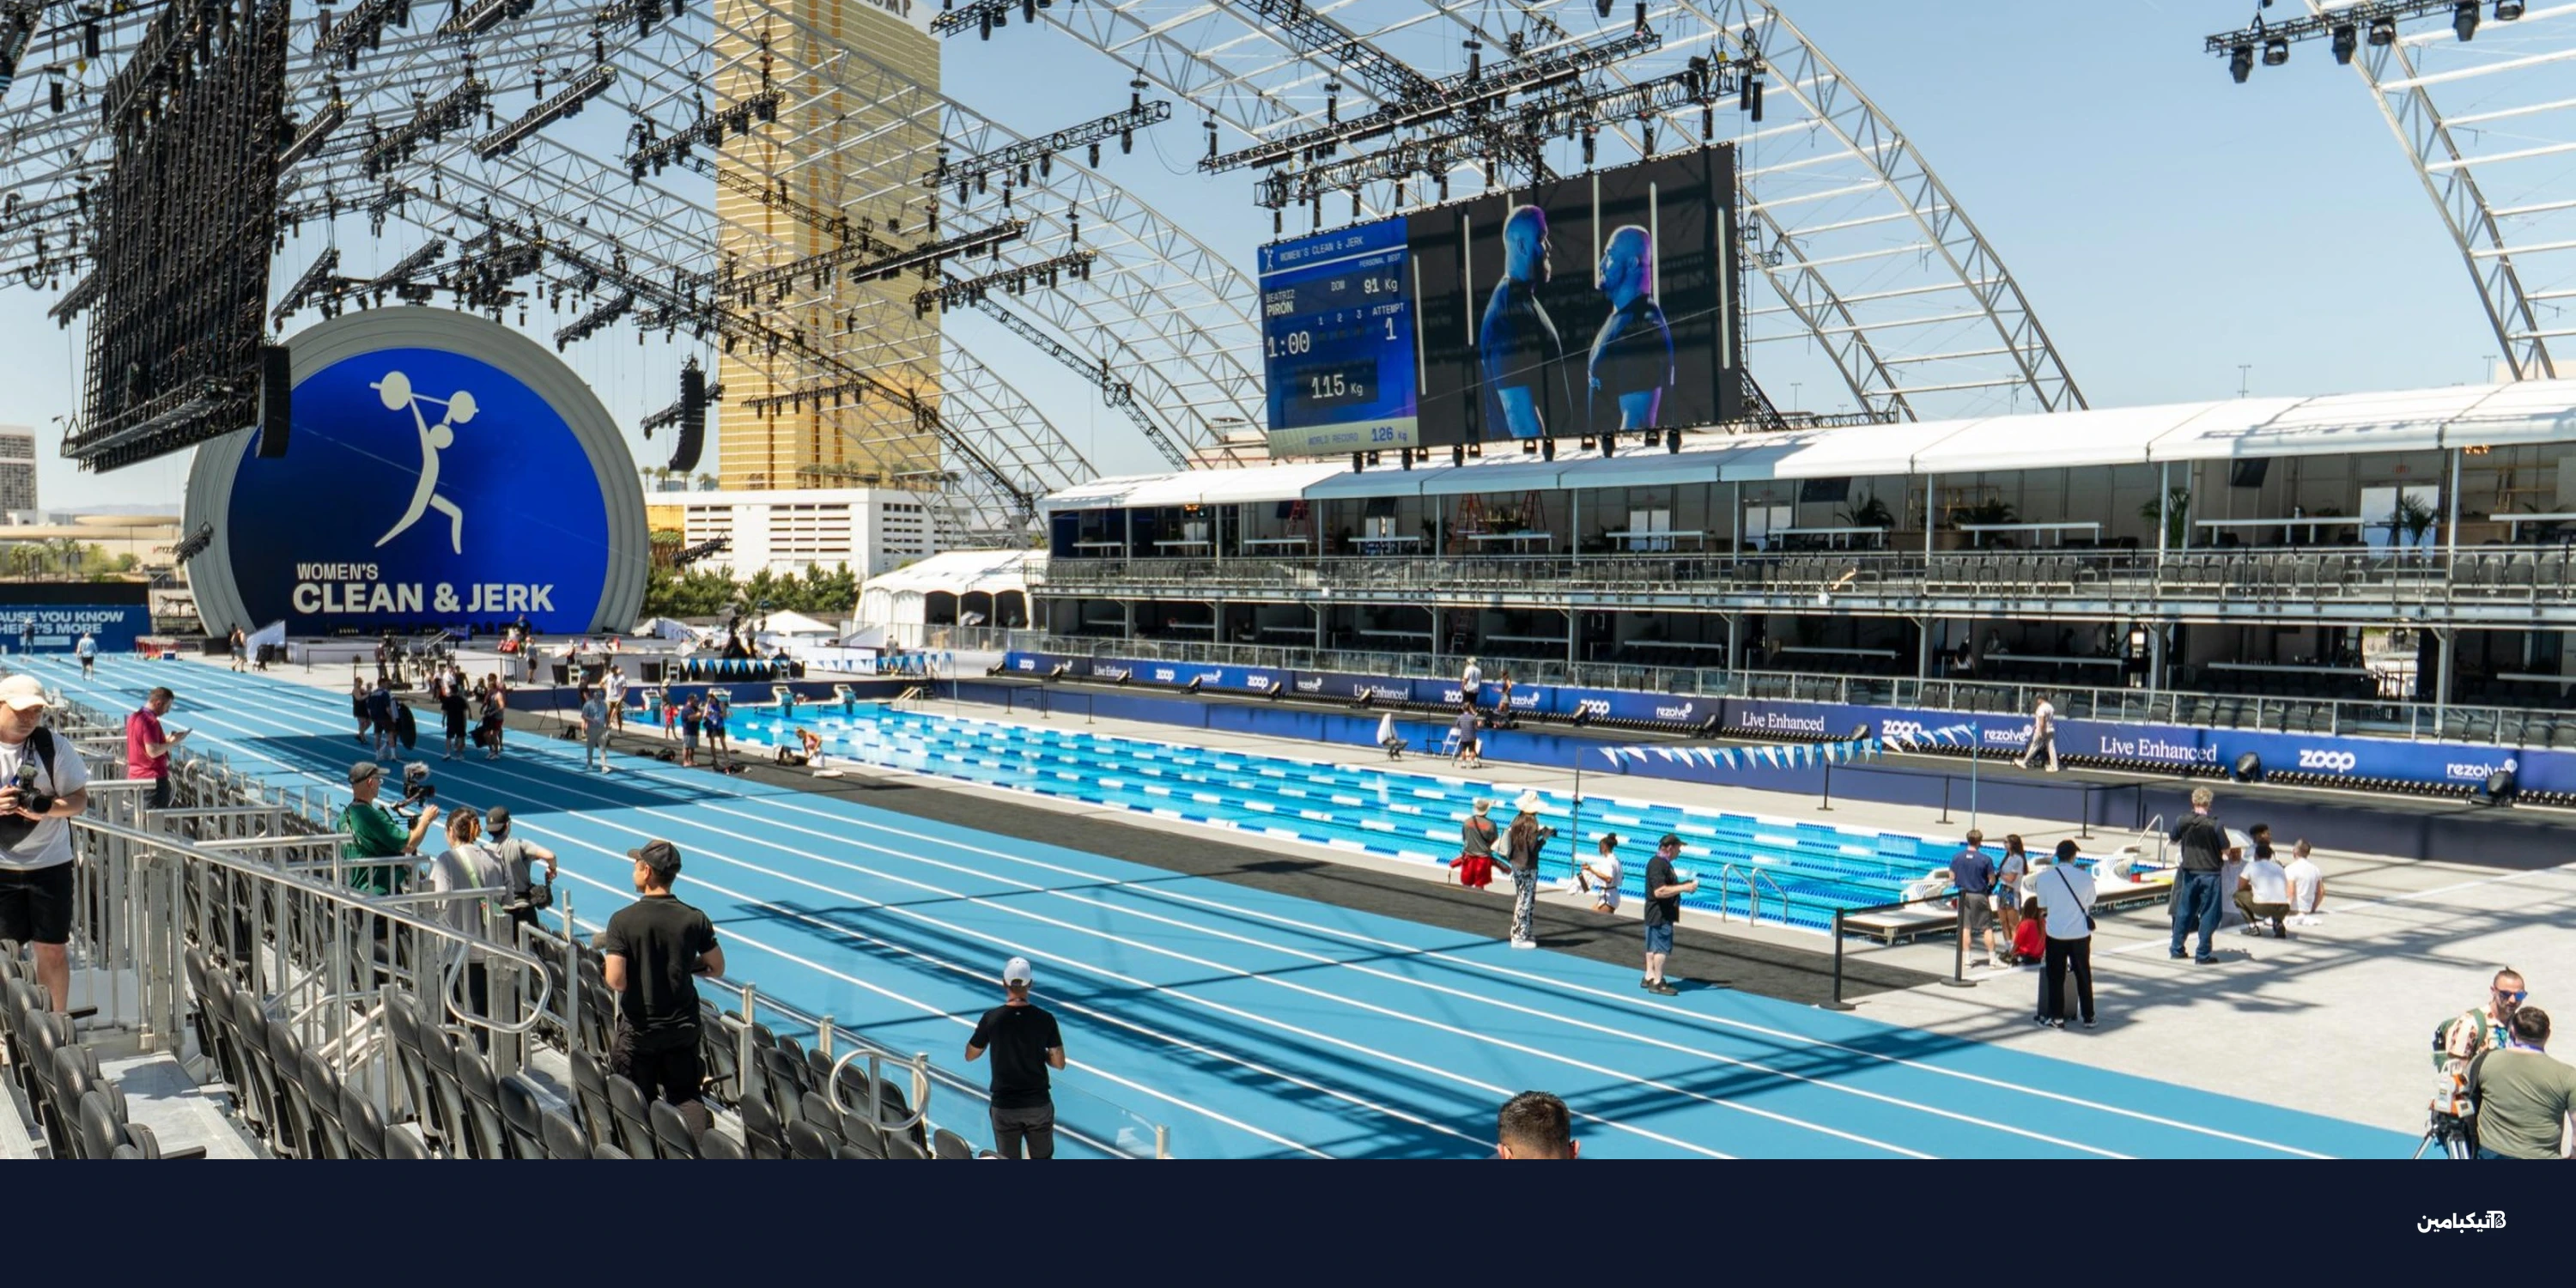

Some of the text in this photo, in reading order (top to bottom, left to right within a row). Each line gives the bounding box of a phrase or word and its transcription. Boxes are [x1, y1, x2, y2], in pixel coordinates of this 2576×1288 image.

[1279, 247, 1309, 262] WOMEN'S
[1312, 242, 1334, 255] CLEAN
[1345, 236, 1364, 248] JERK
[1364, 277, 1380, 294] 91
[1384, 279, 1398, 293] Kg
[1266, 289, 1295, 303] BEATRIZ
[1337, 313, 1343, 323] 2
[1357, 309, 1362, 319] 3
[1372, 302, 1405, 316] ATTEMPT
[1385, 317, 1397, 340] 1
[1267, 331, 1309, 357] 1:00
[1311, 374, 1364, 399] 115 Kg
[1371, 427, 1394, 442] 126
[297, 563, 379, 580] WOMEN'S
[293, 582, 556, 613] CLEAN & JERK
[39, 611, 72, 623] YOU
[75, 611, 125, 623] KNOW
[56, 623, 103, 635] MORE
[1247, 675, 1268, 689] zoop
[1444, 690, 1462, 702] zoo
[1656, 705, 1688, 718] rezolve
[1742, 711, 1825, 732] Live Enhanced
[1984, 729, 2026, 742] rezolve
[2100, 736, 2217, 762] Live Enhanced
[2300, 749, 2355, 773] zoop
